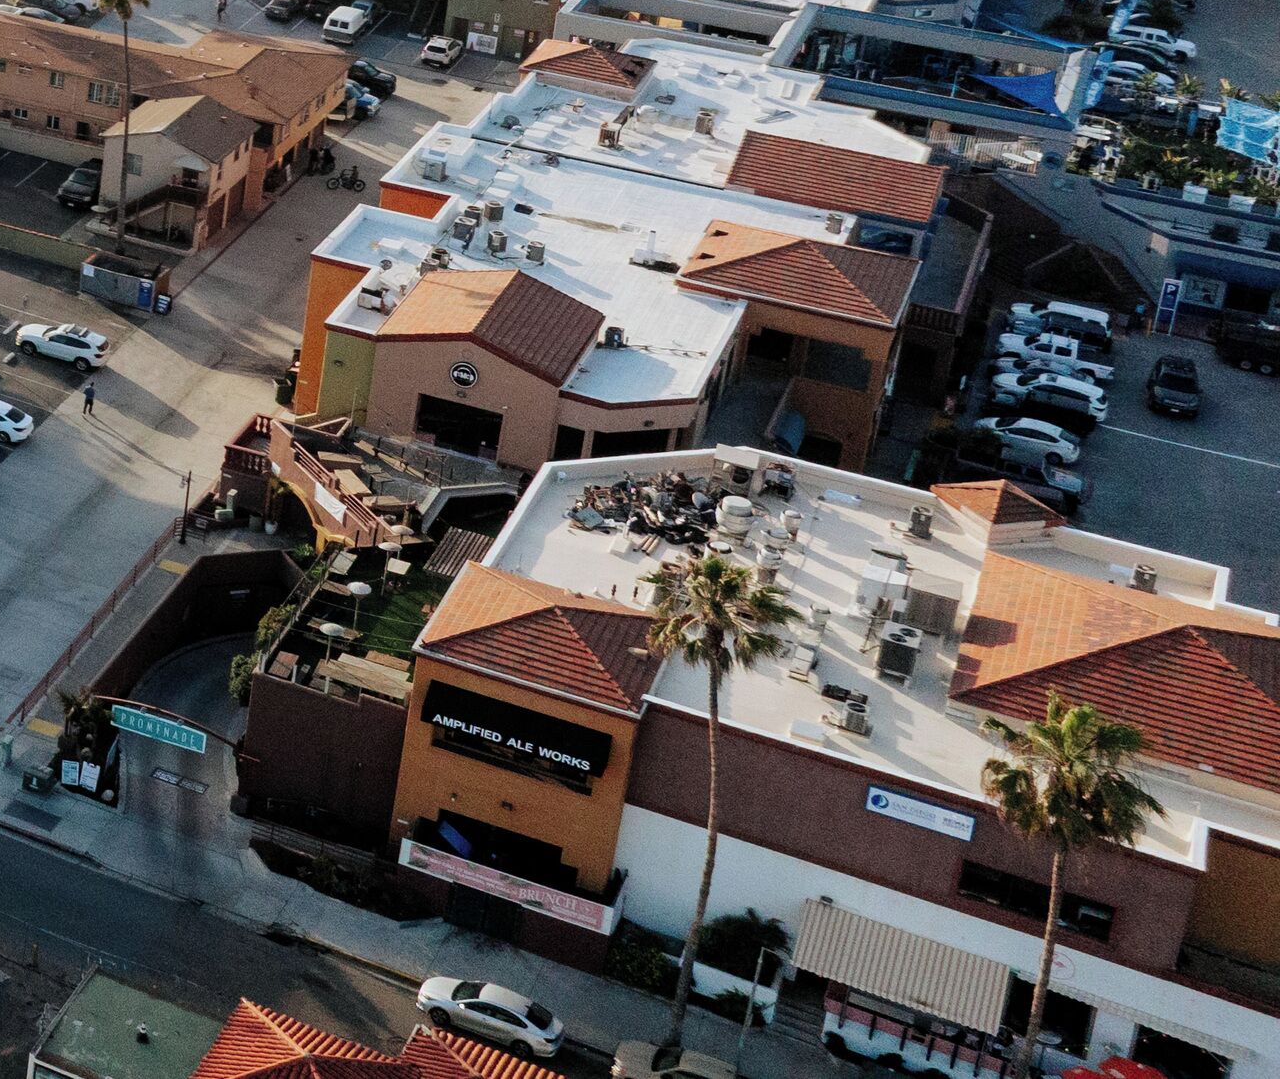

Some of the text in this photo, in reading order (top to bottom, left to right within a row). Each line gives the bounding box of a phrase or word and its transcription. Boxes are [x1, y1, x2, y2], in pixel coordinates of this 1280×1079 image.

[432, 713, 591, 771] AMPLIFIED ALE WORKS
[519, 888, 577, 911] BRUNCH
